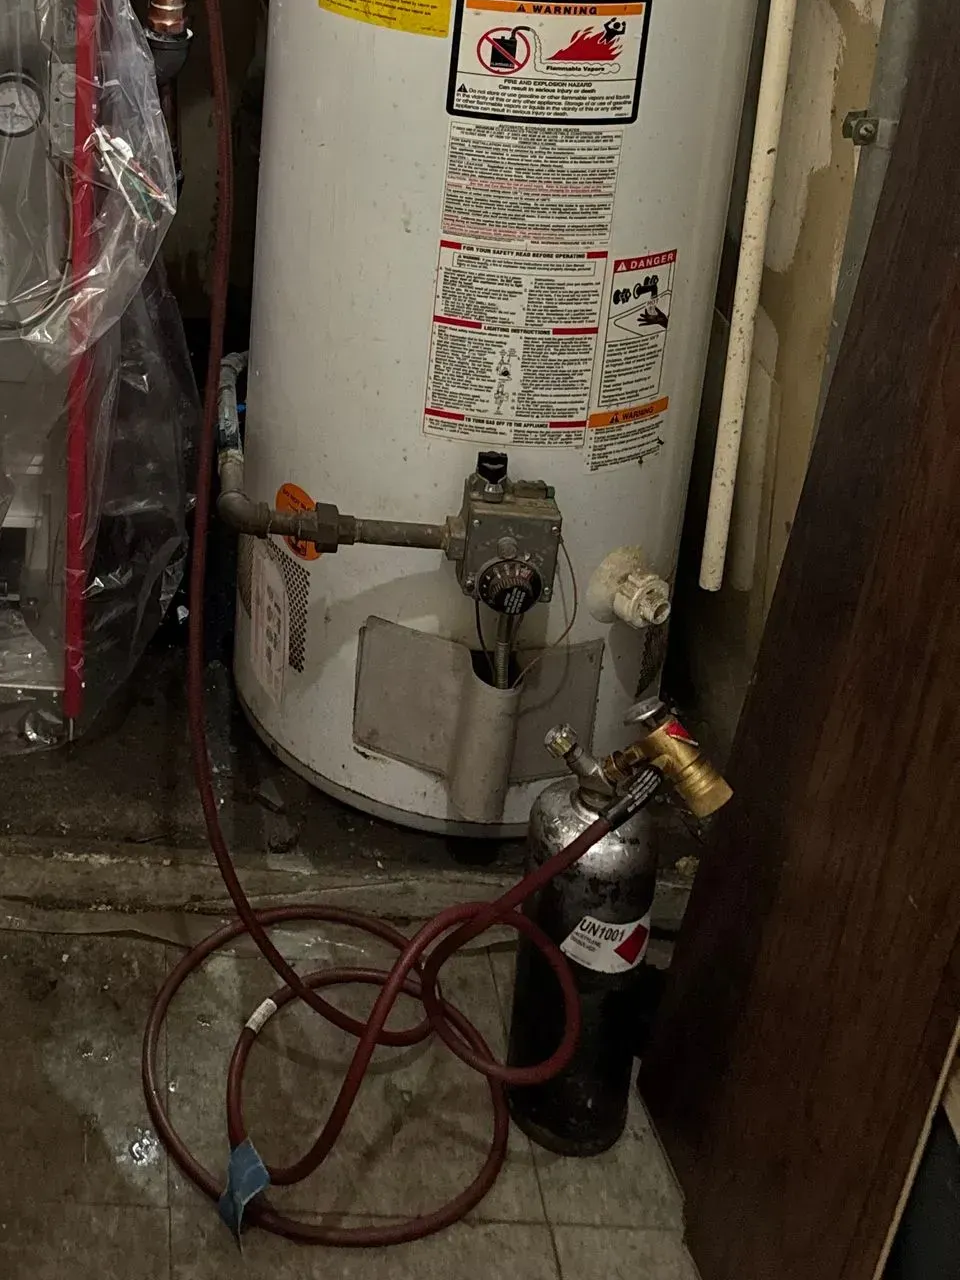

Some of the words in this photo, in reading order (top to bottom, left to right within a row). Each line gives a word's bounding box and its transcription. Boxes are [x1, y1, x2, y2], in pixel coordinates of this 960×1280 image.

[532, 5, 597, 15] WARNING
[630, 253, 674, 269] DANGER
[622, 407, 654, 420] WARNING
[580, 919, 624, 942] UN1001
